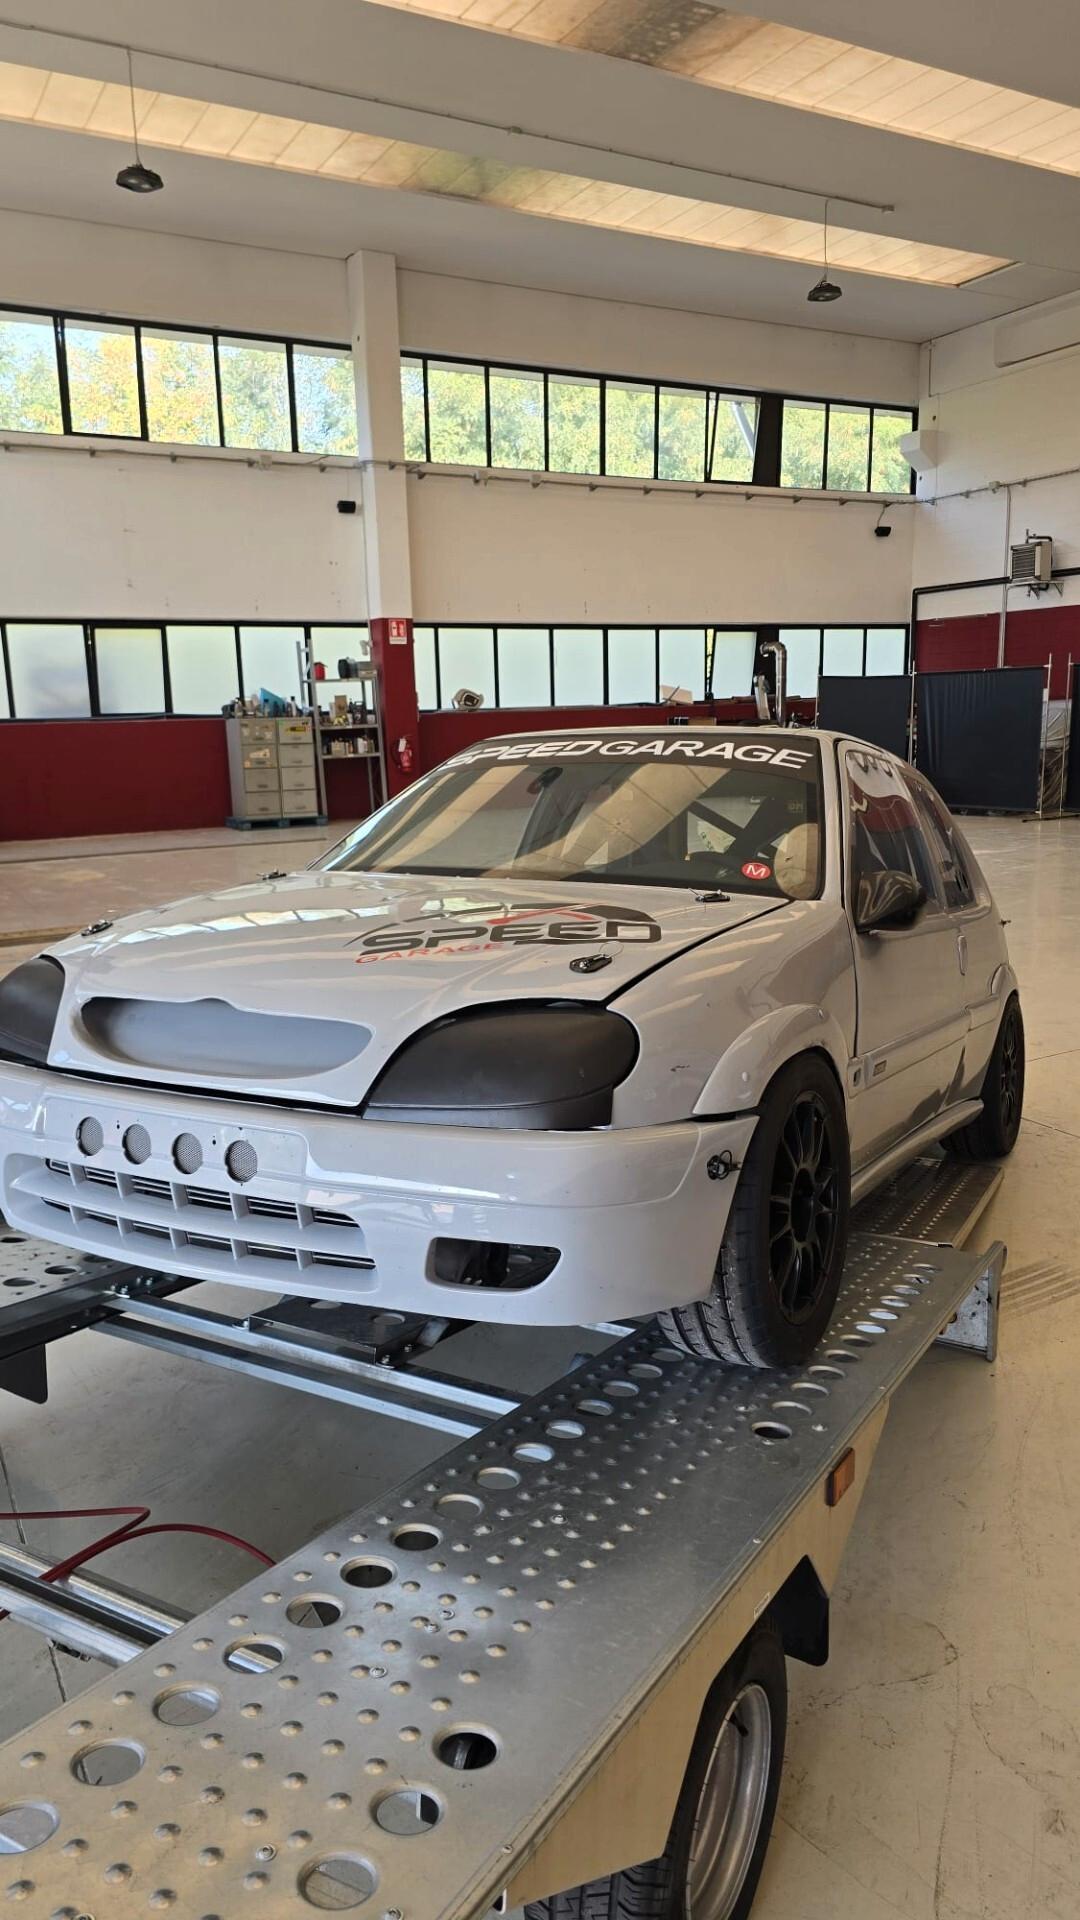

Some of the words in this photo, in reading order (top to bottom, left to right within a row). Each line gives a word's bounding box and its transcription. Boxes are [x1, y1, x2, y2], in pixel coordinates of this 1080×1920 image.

[746, 864, 766, 877] M
[359, 920, 662, 956] SPEED
[355, 942, 504, 964] GARAGE
